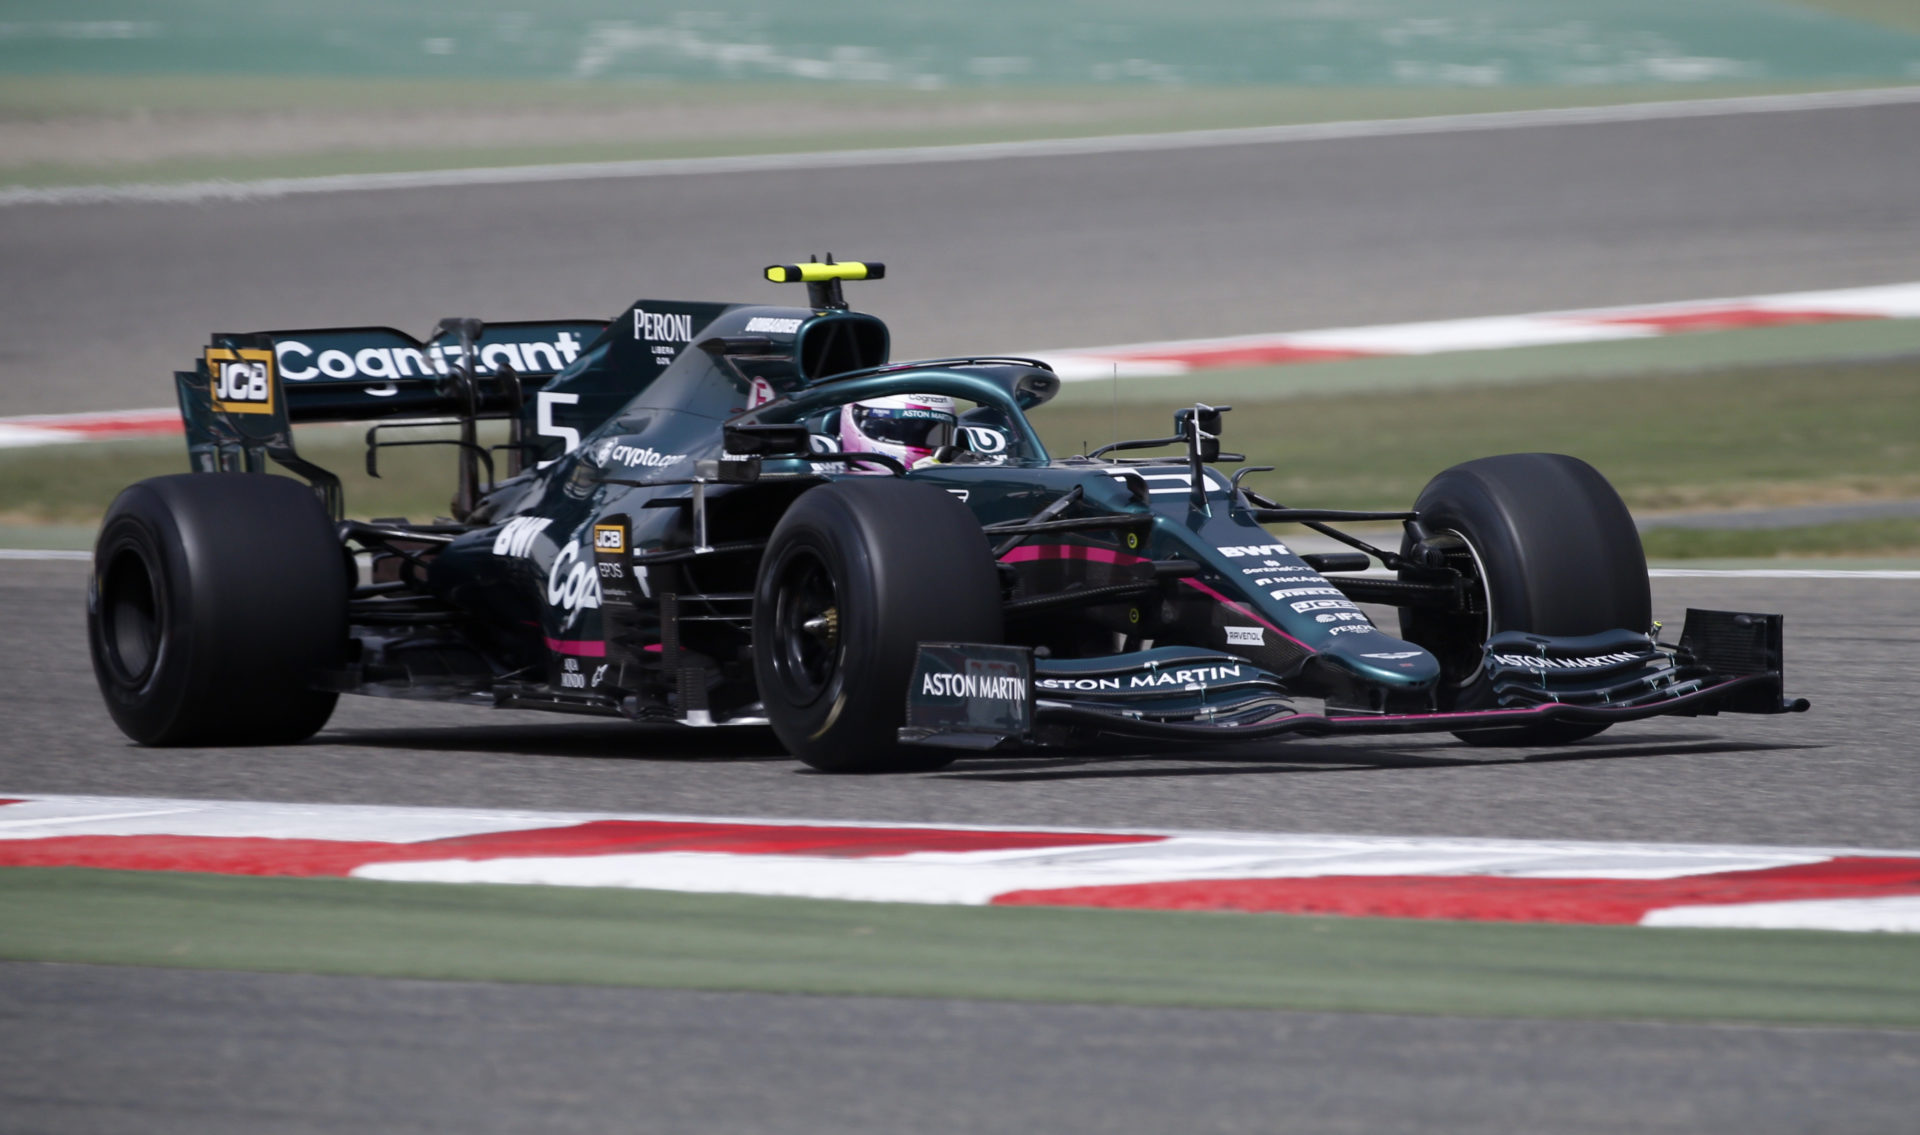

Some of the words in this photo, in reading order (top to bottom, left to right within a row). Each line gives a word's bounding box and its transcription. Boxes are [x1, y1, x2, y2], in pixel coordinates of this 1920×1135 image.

[633, 308, 692, 342] PERONI
[275, 332, 581, 397] Cognizant
[214, 362, 268, 400] JCB
[902, 410, 930, 418] ASTON
[537, 391, 580, 470] 5
[492, 516, 554, 558] BWT
[596, 530, 621, 548] JCB
[1217, 544, 1290, 558] BWT
[598, 562, 624, 578] EPOS
[1229, 632, 1261, 641] RAVENOL
[1328, 624, 1377, 636] PERON
[1493, 653, 1561, 669] ASTON
[1556, 651, 1640, 669] MARTIN
[922, 672, 977, 698] ASTON
[980, 676, 1026, 700] MARTIN
[1130, 665, 1241, 689] MARTIN
